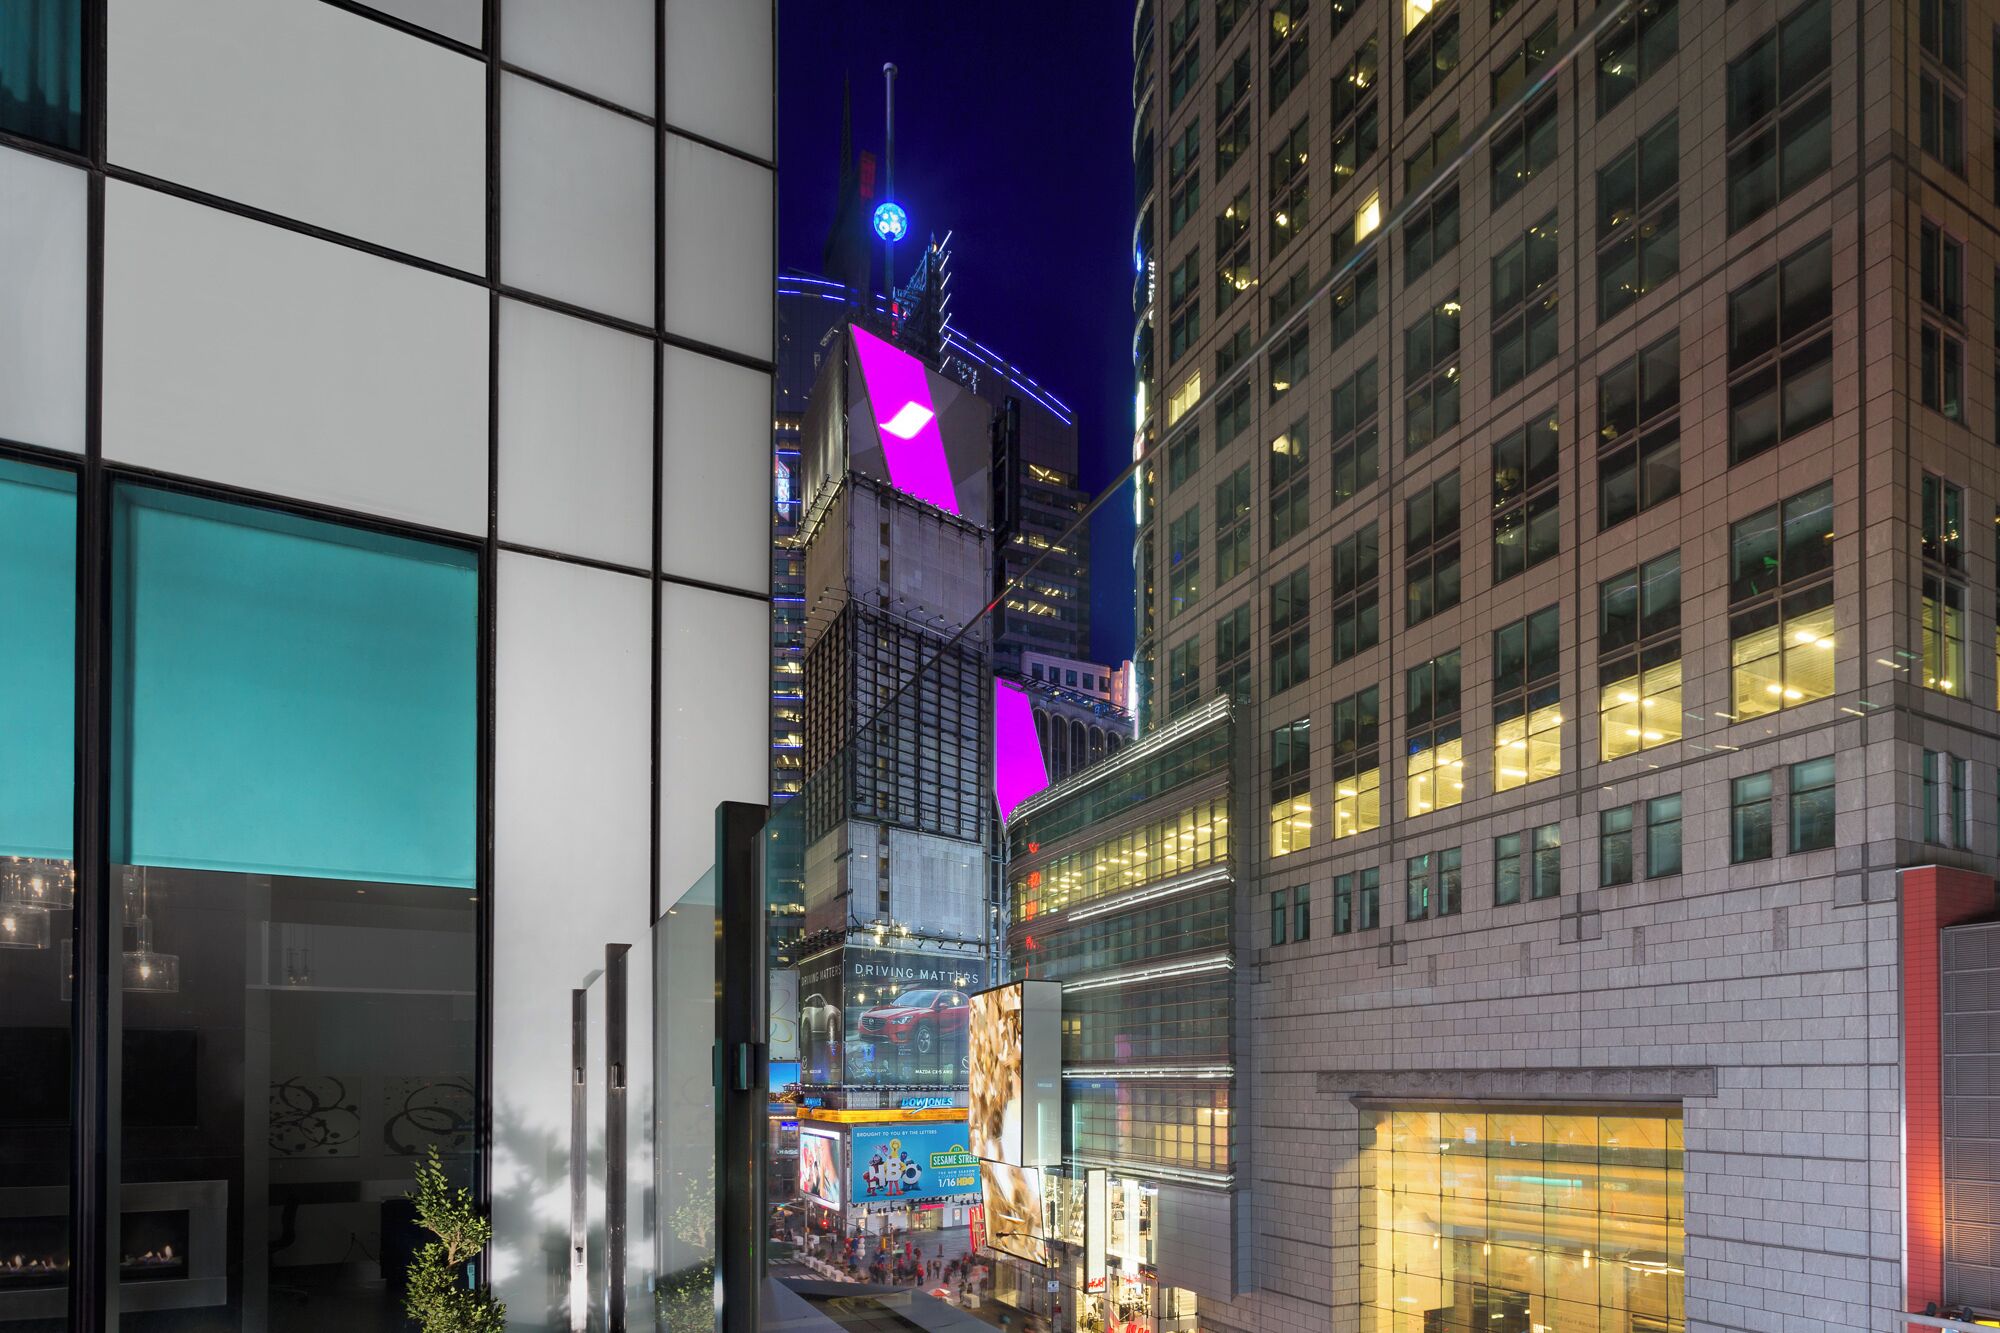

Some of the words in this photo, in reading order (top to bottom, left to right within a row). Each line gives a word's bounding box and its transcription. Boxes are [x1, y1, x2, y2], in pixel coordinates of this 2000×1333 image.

[855, 963, 914, 979] DRIVING
[920, 969, 979, 984] MATTERS
[933, 1155, 957, 1166] SESAME
[958, 1154, 979, 1164] STREET
[938, 1178, 956, 1188] 1/16
